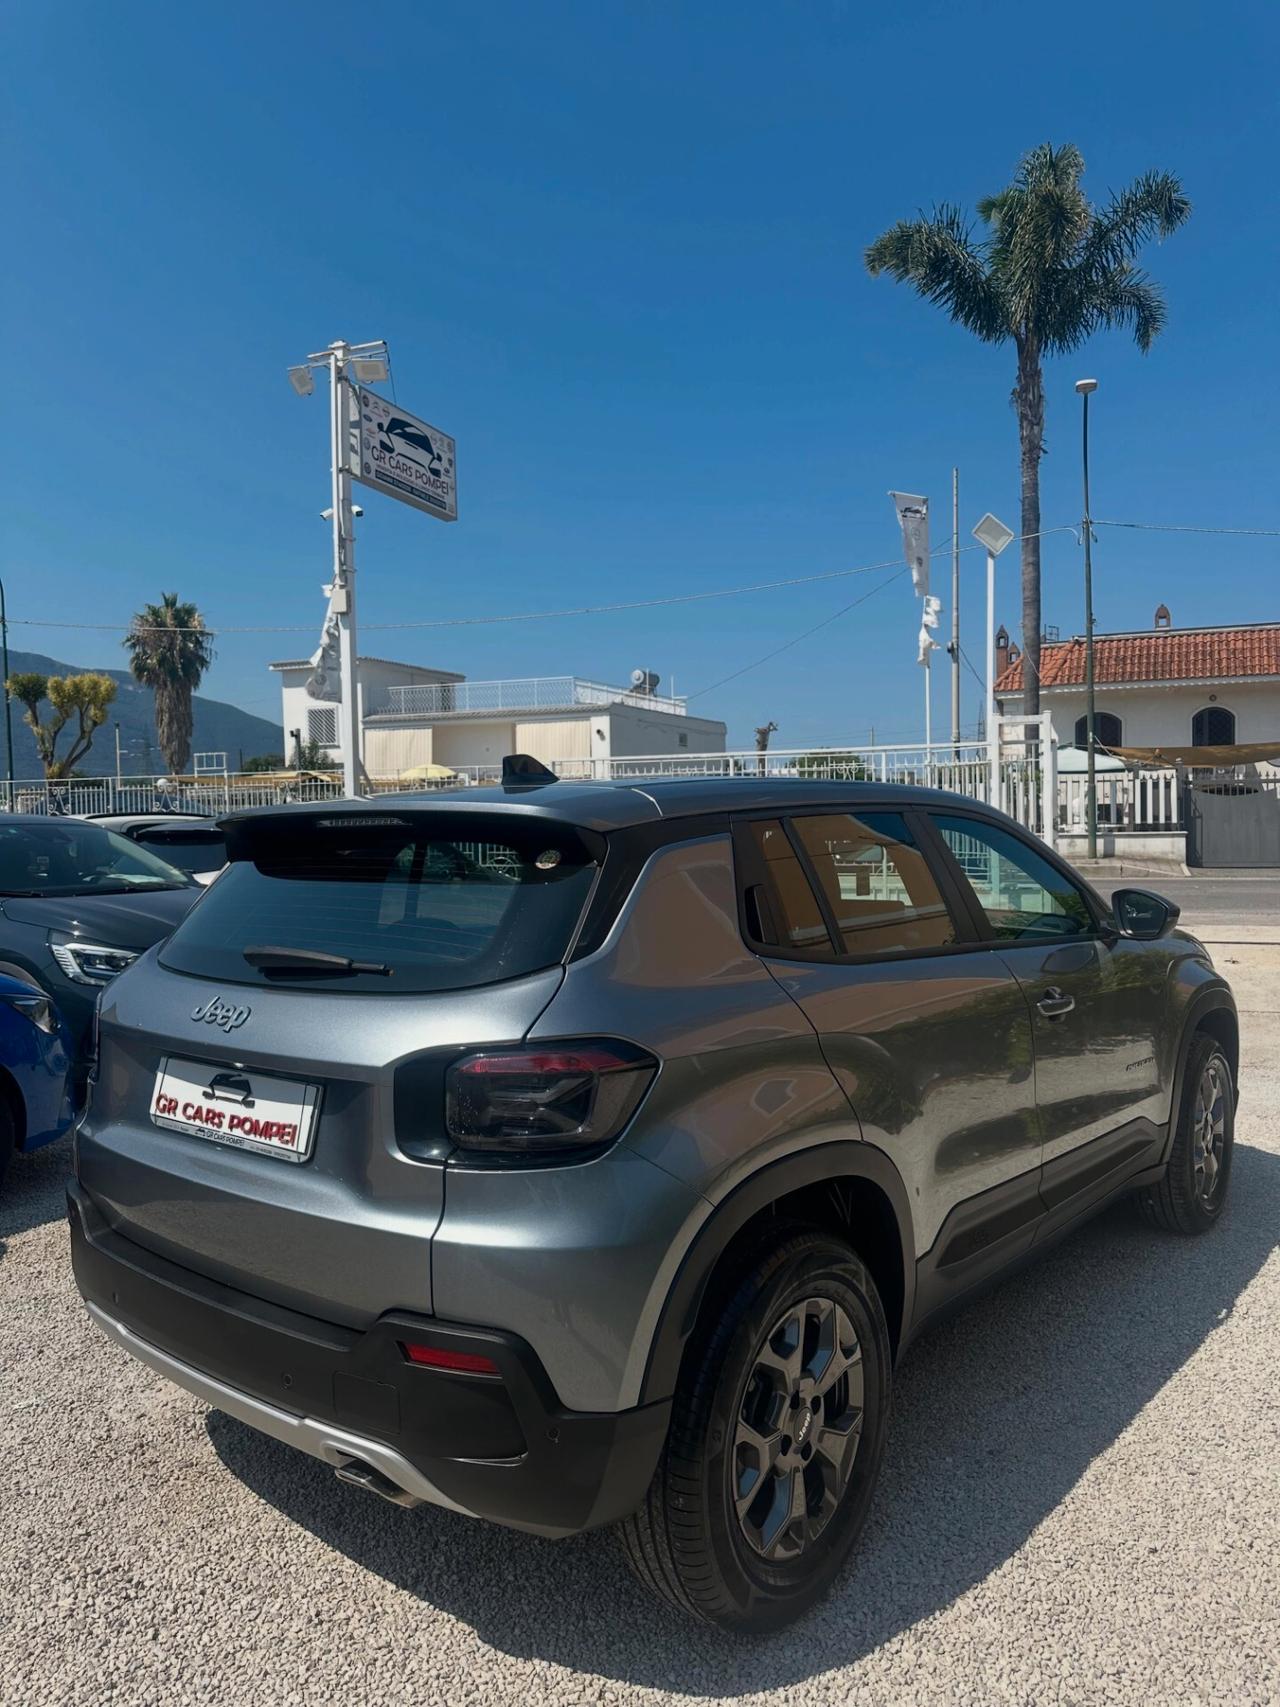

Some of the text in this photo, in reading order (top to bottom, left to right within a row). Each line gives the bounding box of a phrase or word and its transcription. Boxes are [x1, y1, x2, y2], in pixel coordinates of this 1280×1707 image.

[371, 445, 386, 465] GR
[389, 456, 413, 477] CARS
[415, 470, 448, 495] POMPEI
[191, 996, 252, 1033] Jeep
[156, 1093, 298, 1147] GR CARS POMPEI
